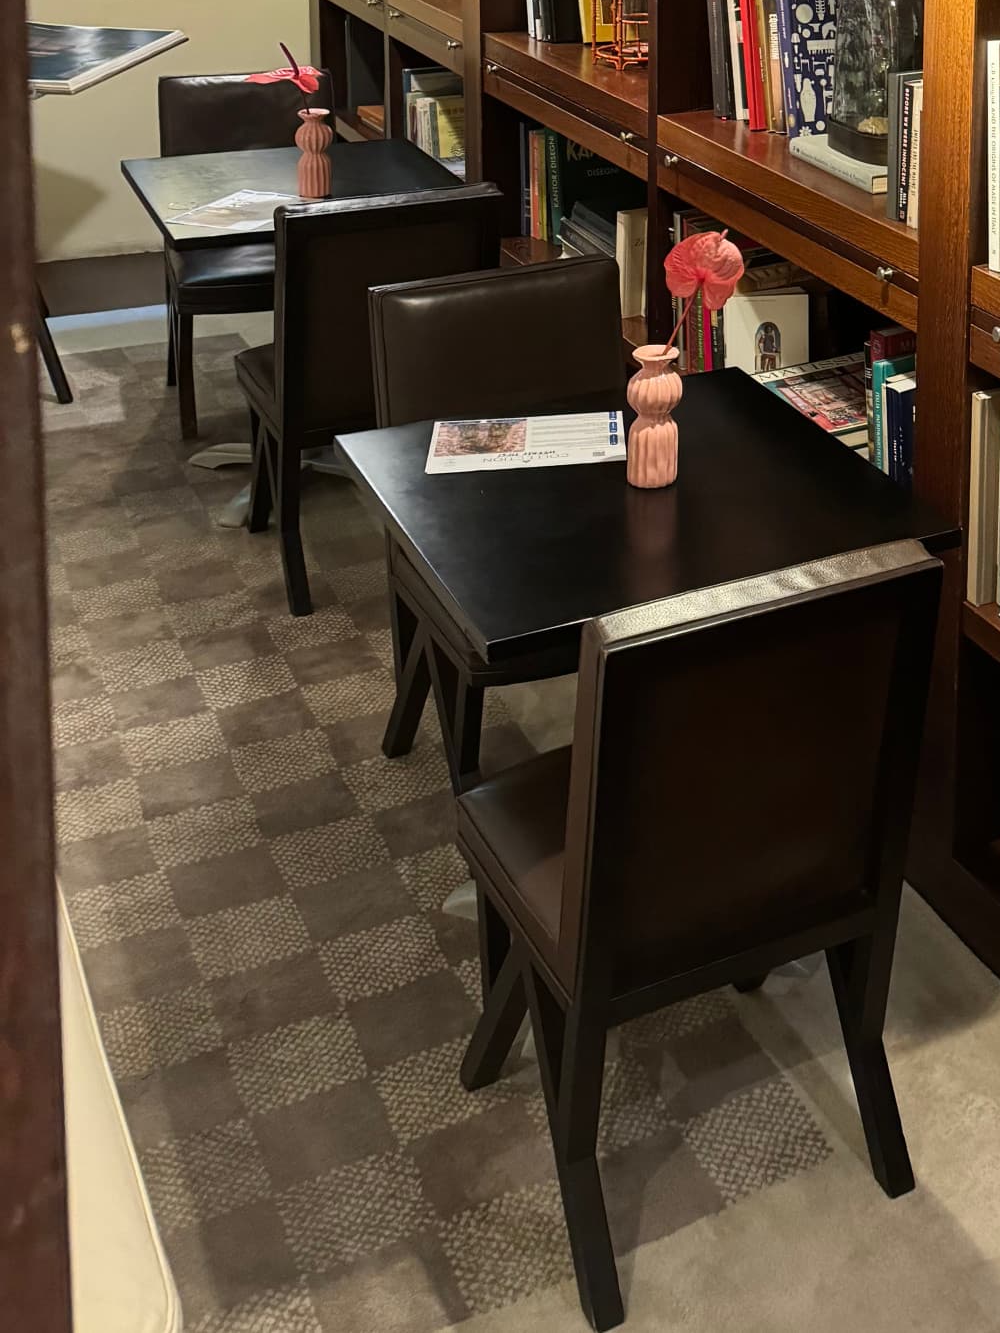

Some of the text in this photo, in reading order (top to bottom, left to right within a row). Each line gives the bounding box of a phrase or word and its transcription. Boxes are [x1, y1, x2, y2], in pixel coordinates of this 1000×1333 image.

[769, 13, 779, 60] EQUILIBRIUM
[903, 116, 909, 126] WE
[548, 135, 557, 168] DISEGNI
[757, 355, 864, 382] MATISSE
